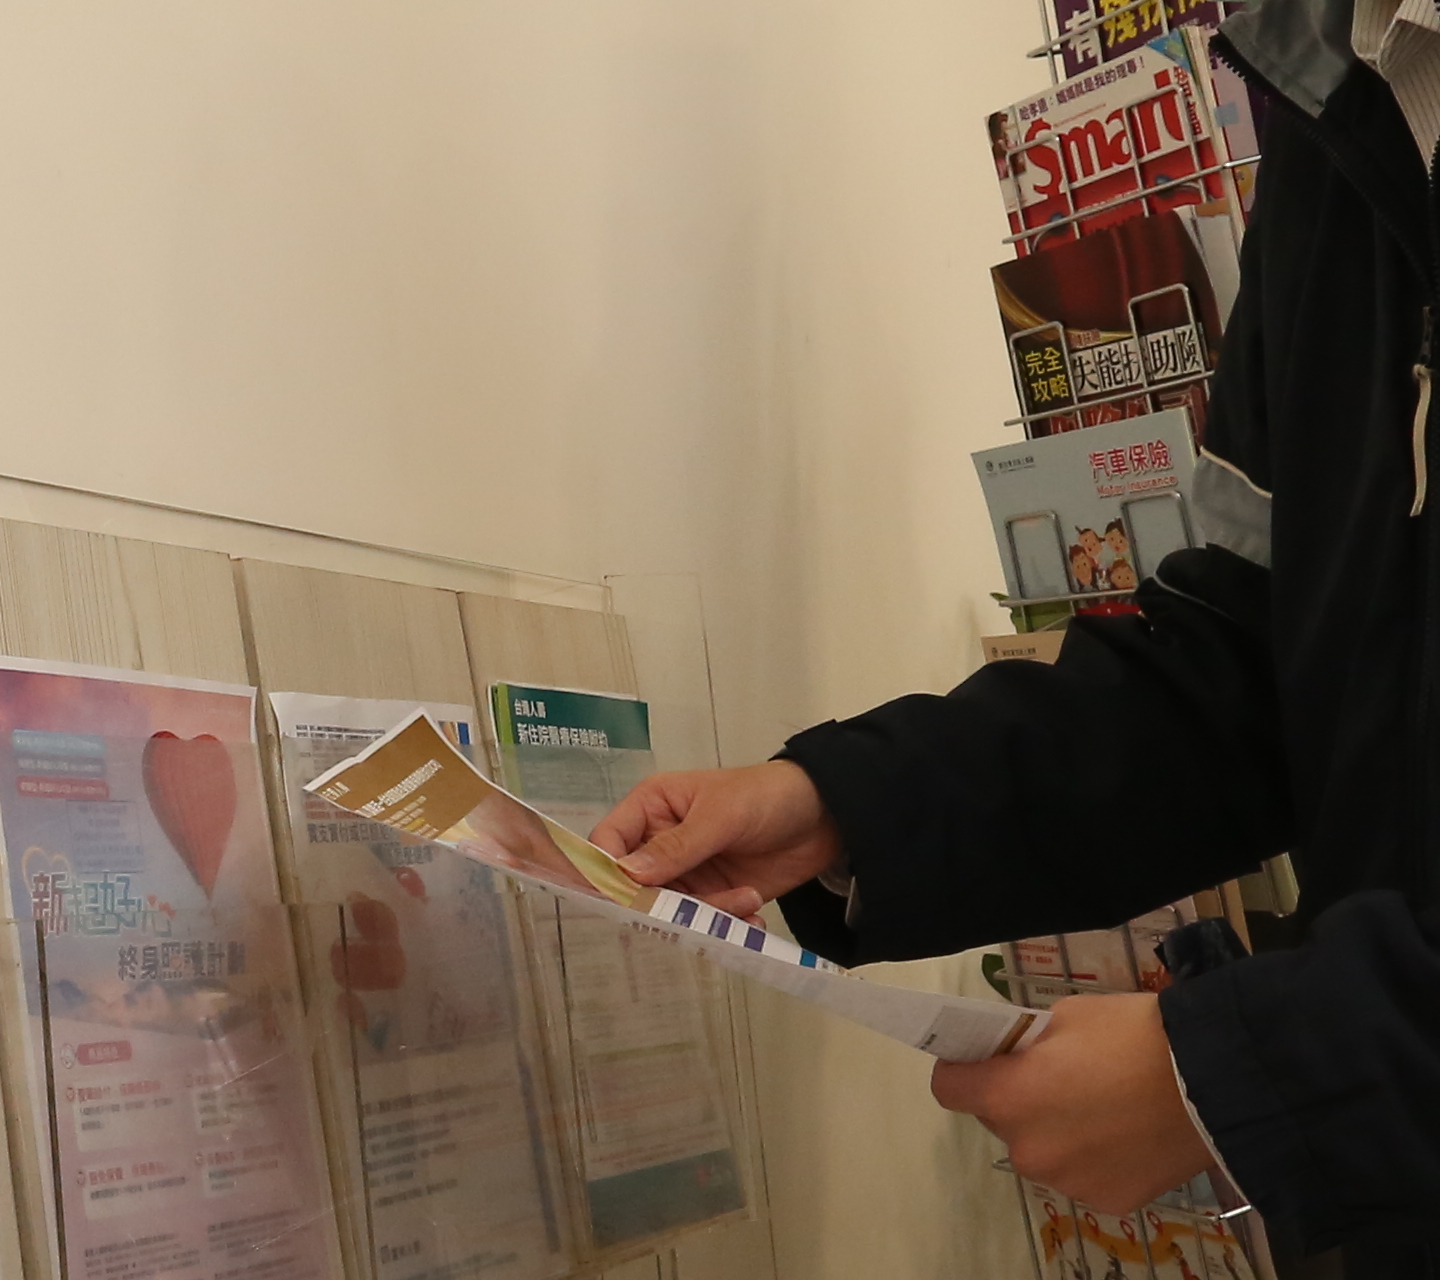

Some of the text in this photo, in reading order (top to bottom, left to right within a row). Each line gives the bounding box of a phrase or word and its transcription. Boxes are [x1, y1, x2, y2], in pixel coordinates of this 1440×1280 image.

[1024, 346, 1064, 377] 完全
[1071, 324, 1204, 395] 失能扶助險
[1031, 378, 1070, 403] 攻略
[1088, 439, 1172, 482] 汽車保險
[514, 698, 547, 719] 台灣人壽
